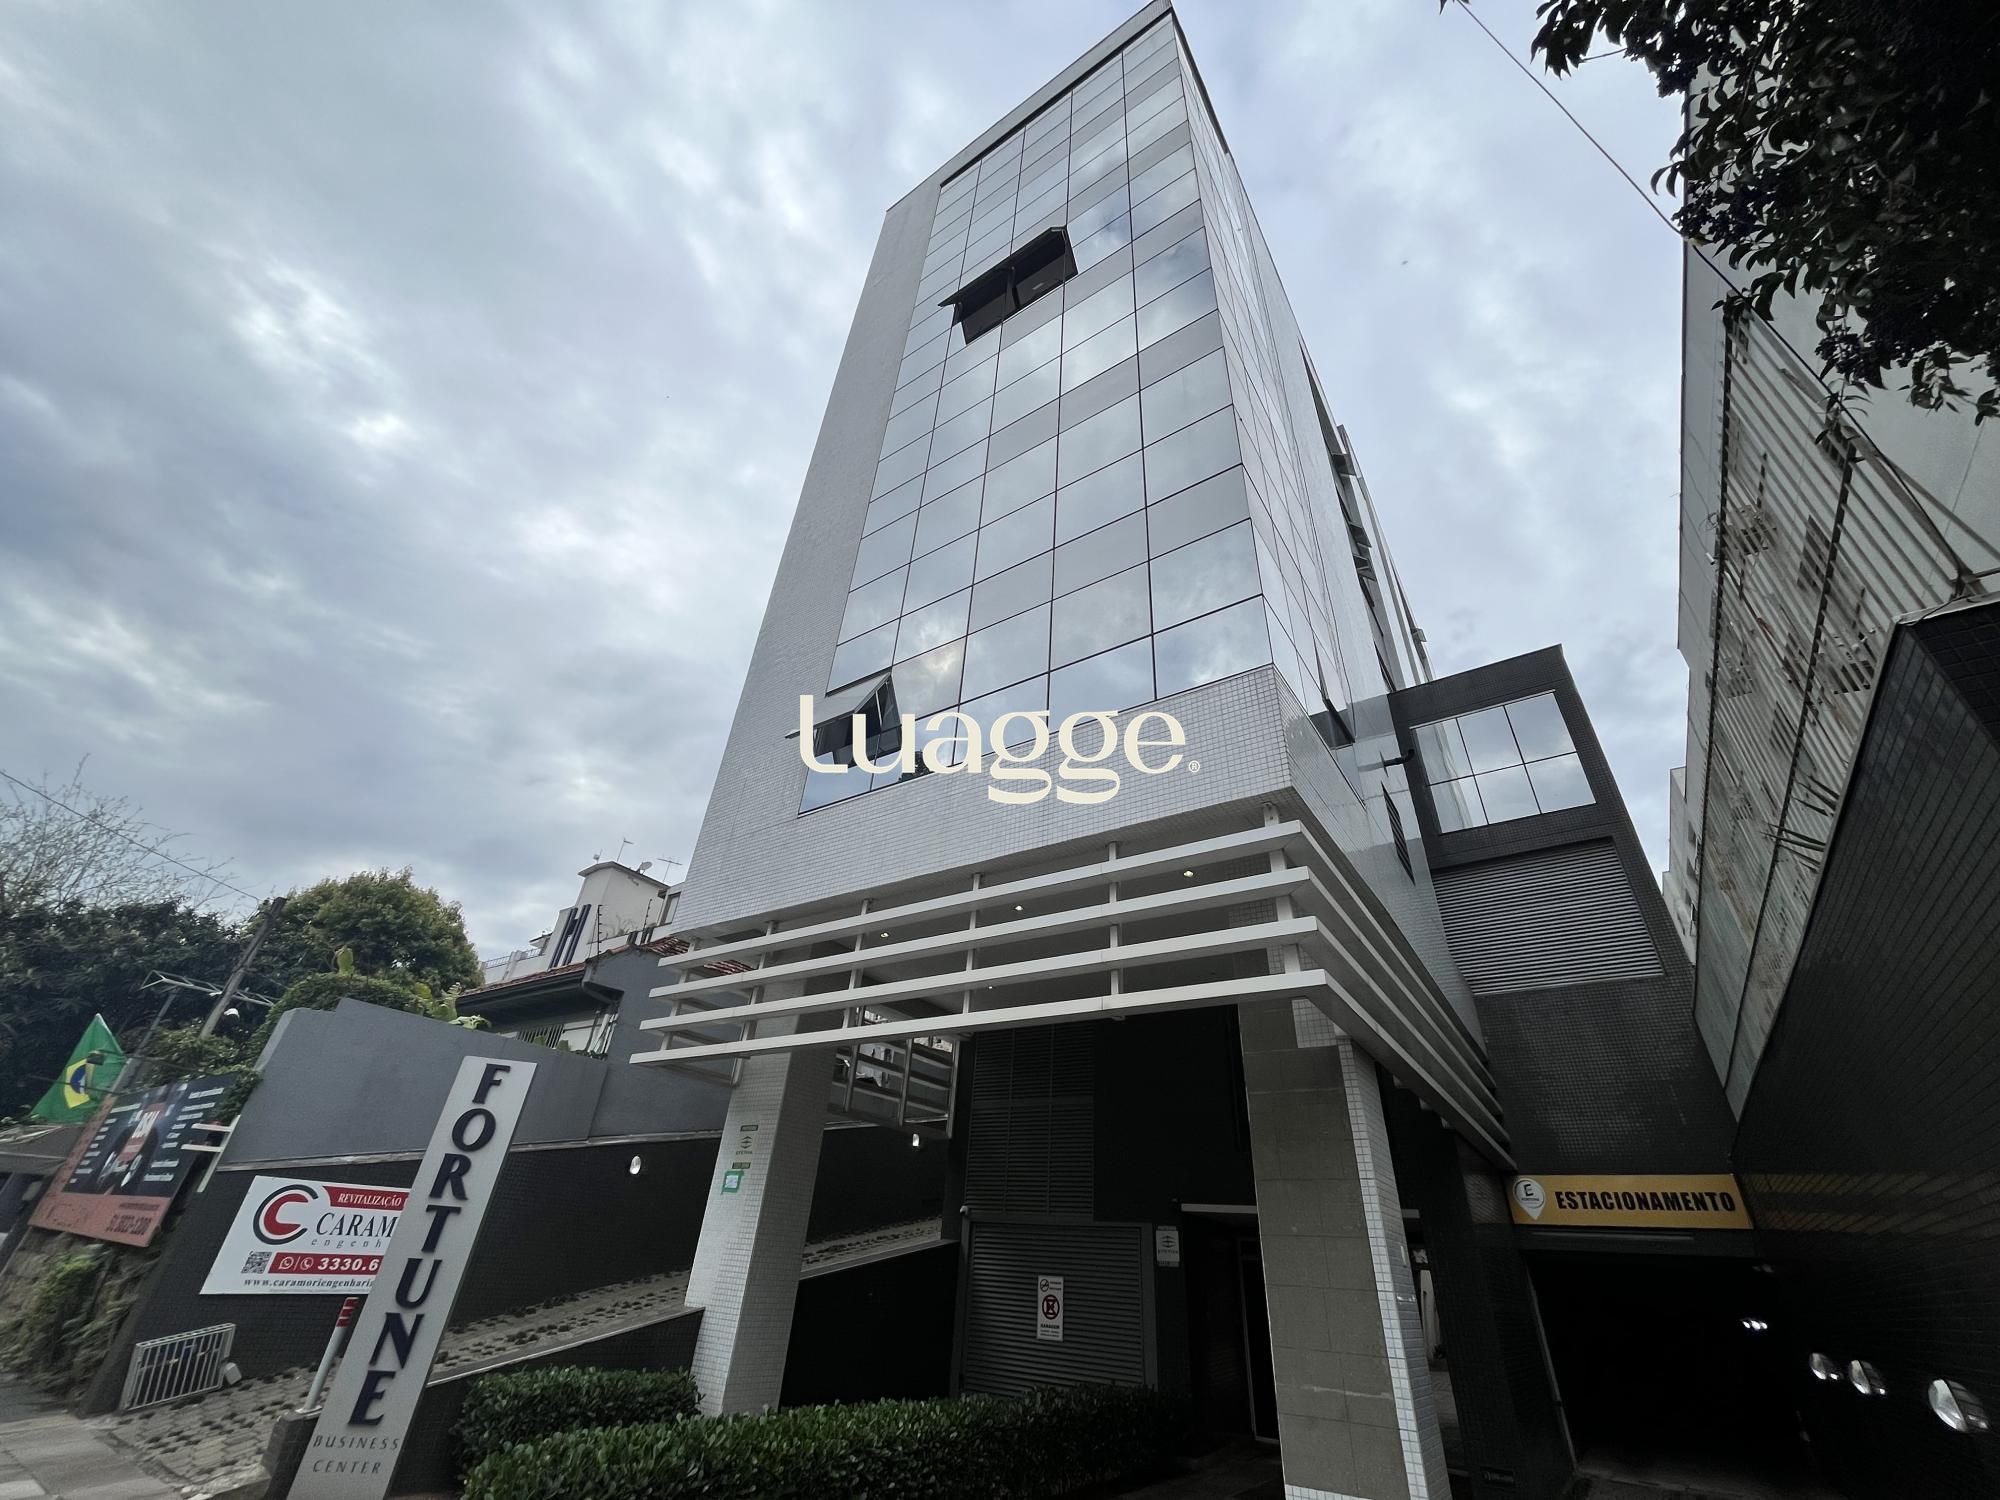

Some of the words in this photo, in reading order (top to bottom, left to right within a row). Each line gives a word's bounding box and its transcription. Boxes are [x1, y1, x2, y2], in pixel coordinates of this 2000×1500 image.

[1554, 1190, 1736, 1212] ESTACIONAMENTO
[347, 1062, 511, 1428] FORTUNE
[313, 1435, 401, 1450] BUSINESS
[312, 1459, 383, 1474] CENTER
